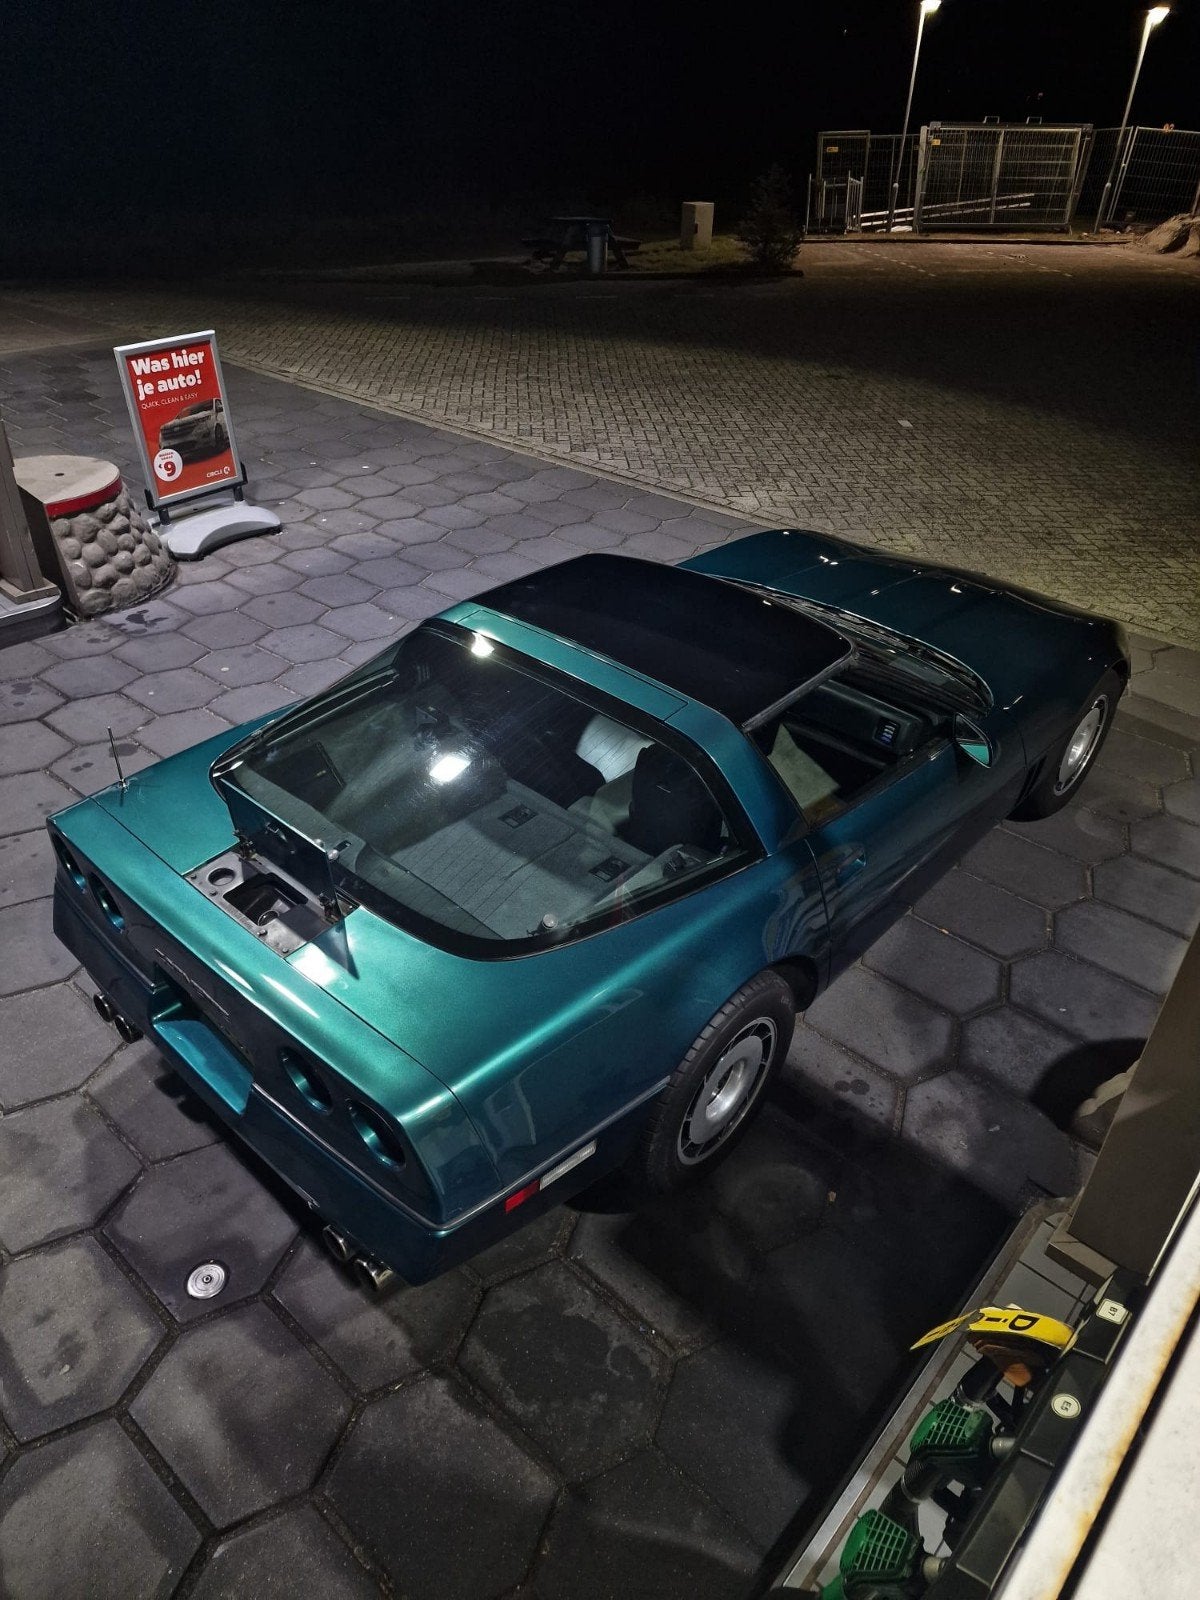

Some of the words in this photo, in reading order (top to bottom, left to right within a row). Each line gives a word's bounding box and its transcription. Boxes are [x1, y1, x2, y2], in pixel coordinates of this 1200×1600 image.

[131, 357, 170, 376] Was
[171, 349, 205, 369] hier
[137, 379, 155, 401] je
[157, 369, 202, 393] auto!
[161, 397, 180, 405] CLEAN
[184, 392, 198, 400] EASY
[1060, 1400, 1072, 1412] E5
